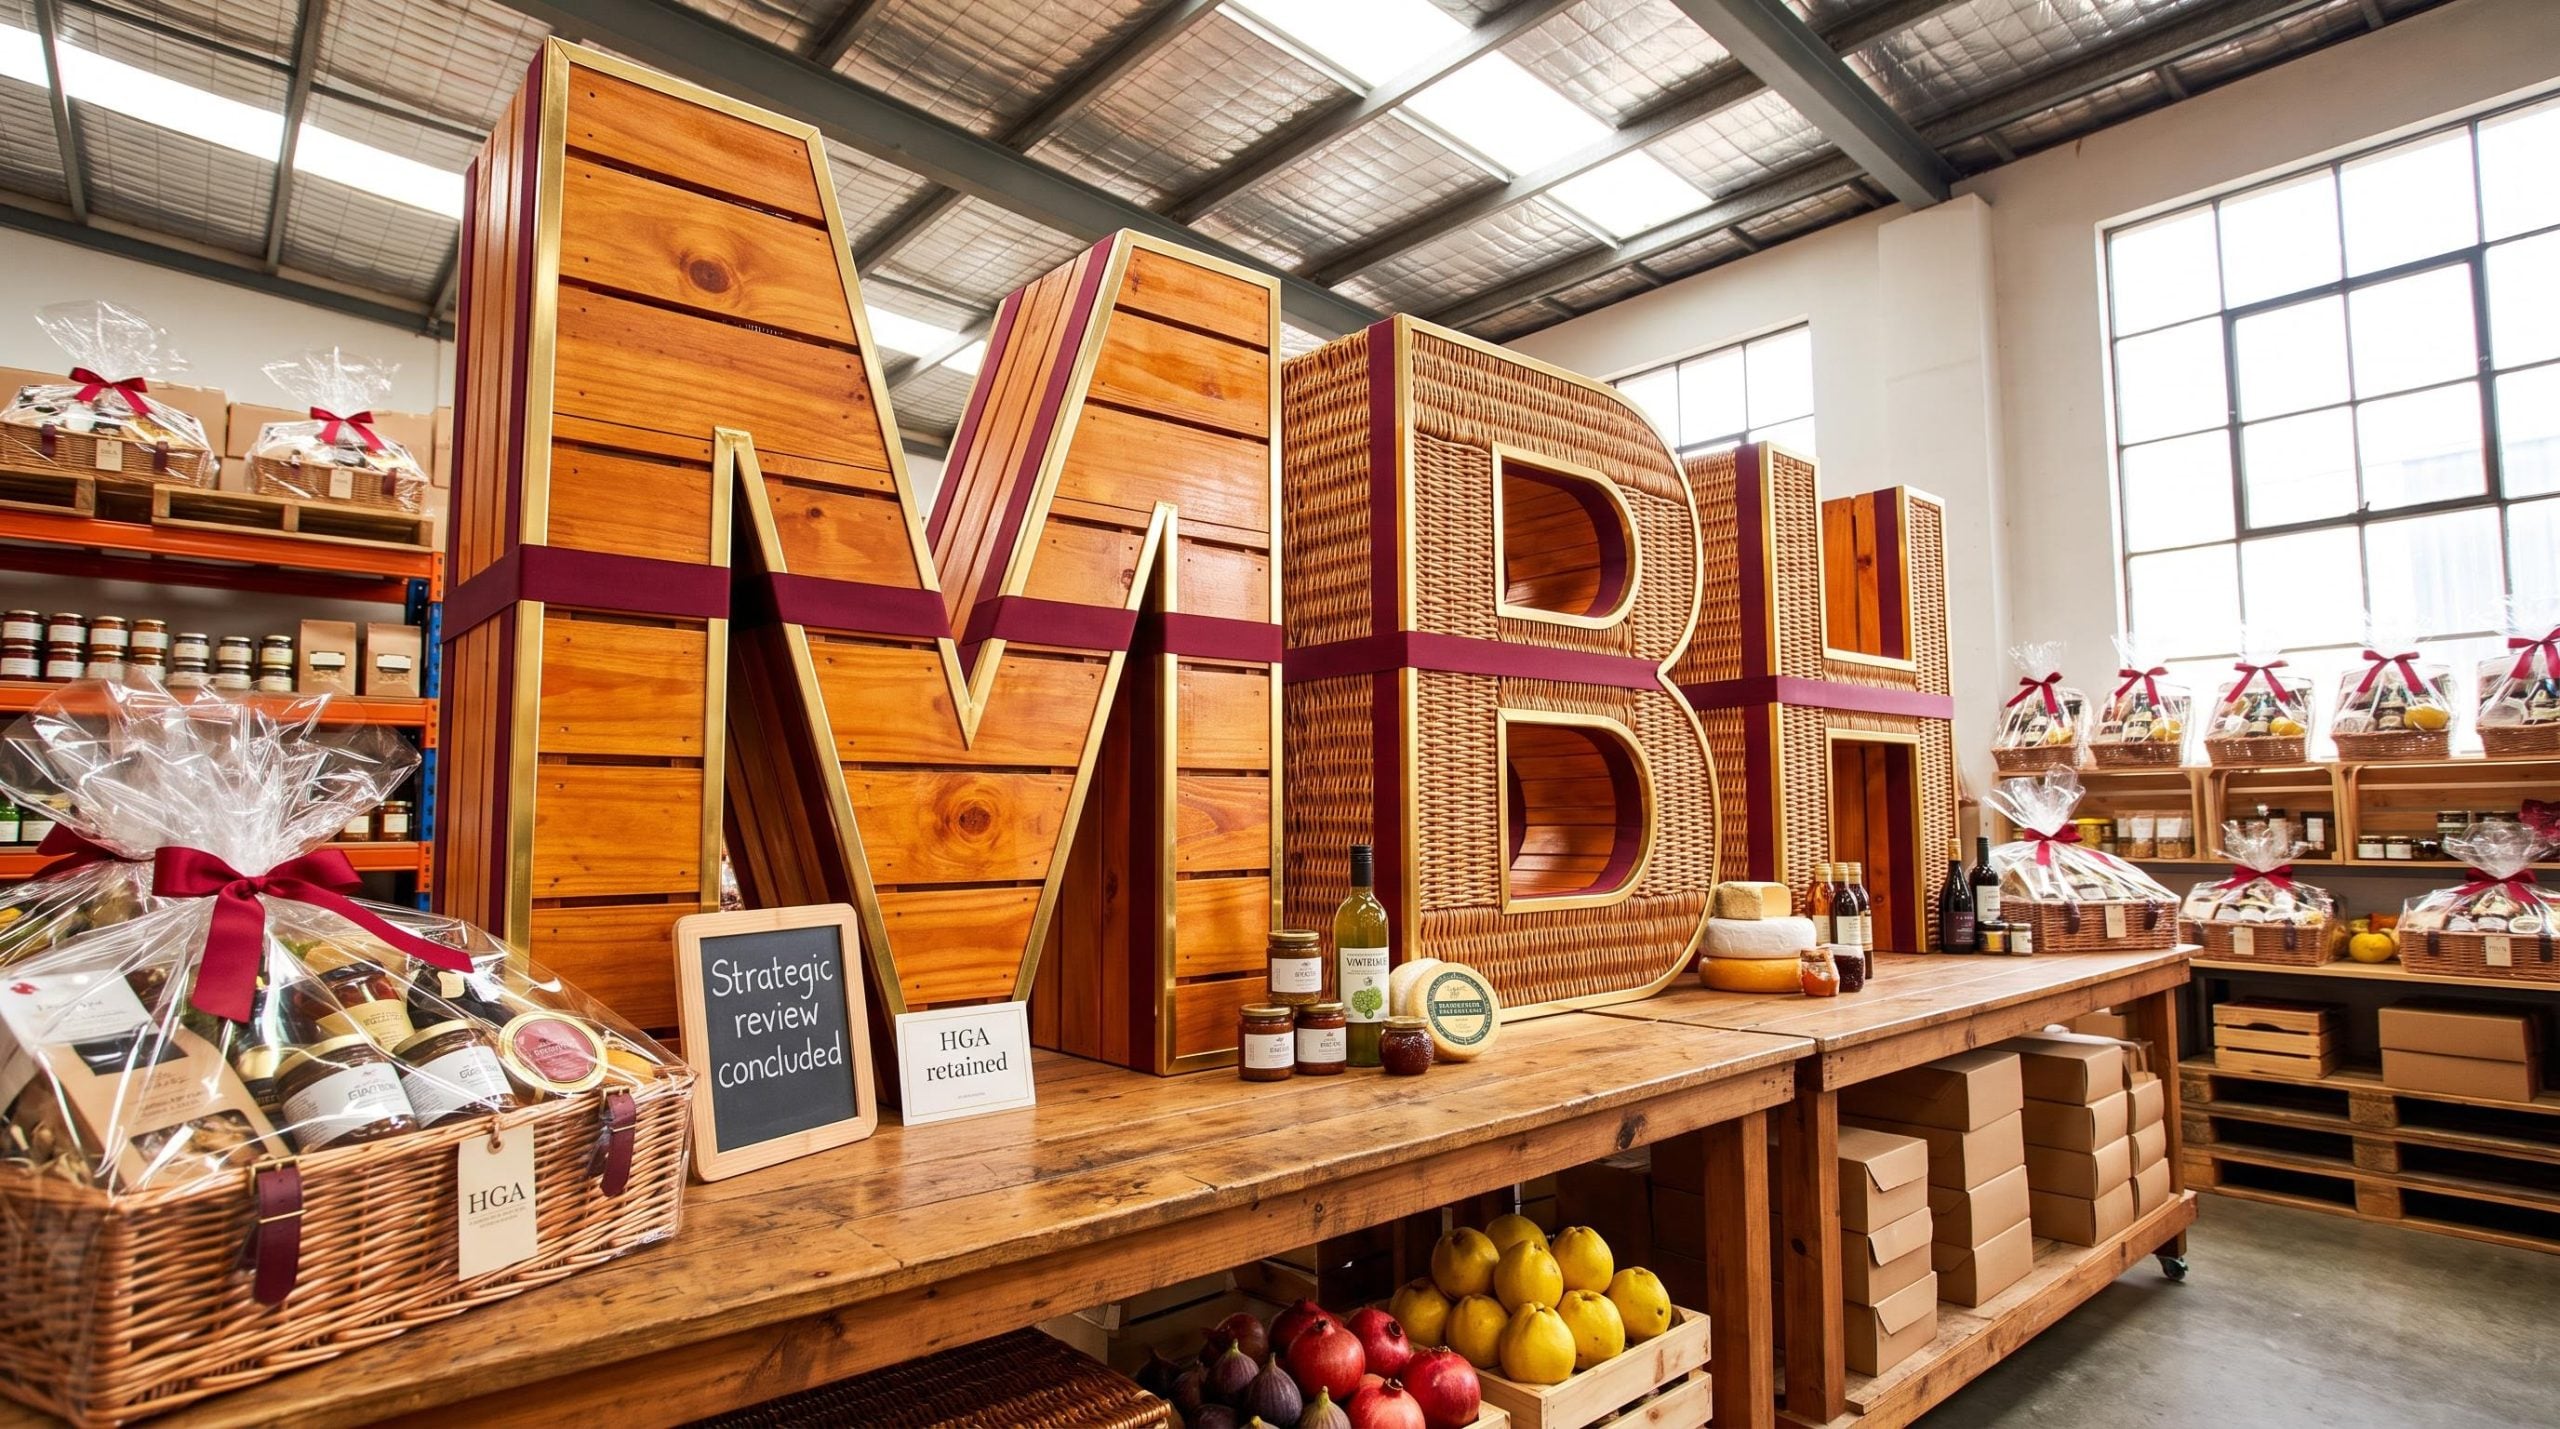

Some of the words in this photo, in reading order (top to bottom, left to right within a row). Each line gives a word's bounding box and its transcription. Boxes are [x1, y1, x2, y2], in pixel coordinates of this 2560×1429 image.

[442, 38, 1955, 1077] MBH
[711, 953, 834, 1000] Strategic
[734, 1001, 819, 1039] review
[940, 1026, 991, 1052] HGA
[718, 1030, 842, 1089] concluded
[926, 1051, 1009, 1082] retained
[468, 1181, 527, 1215] HGA
